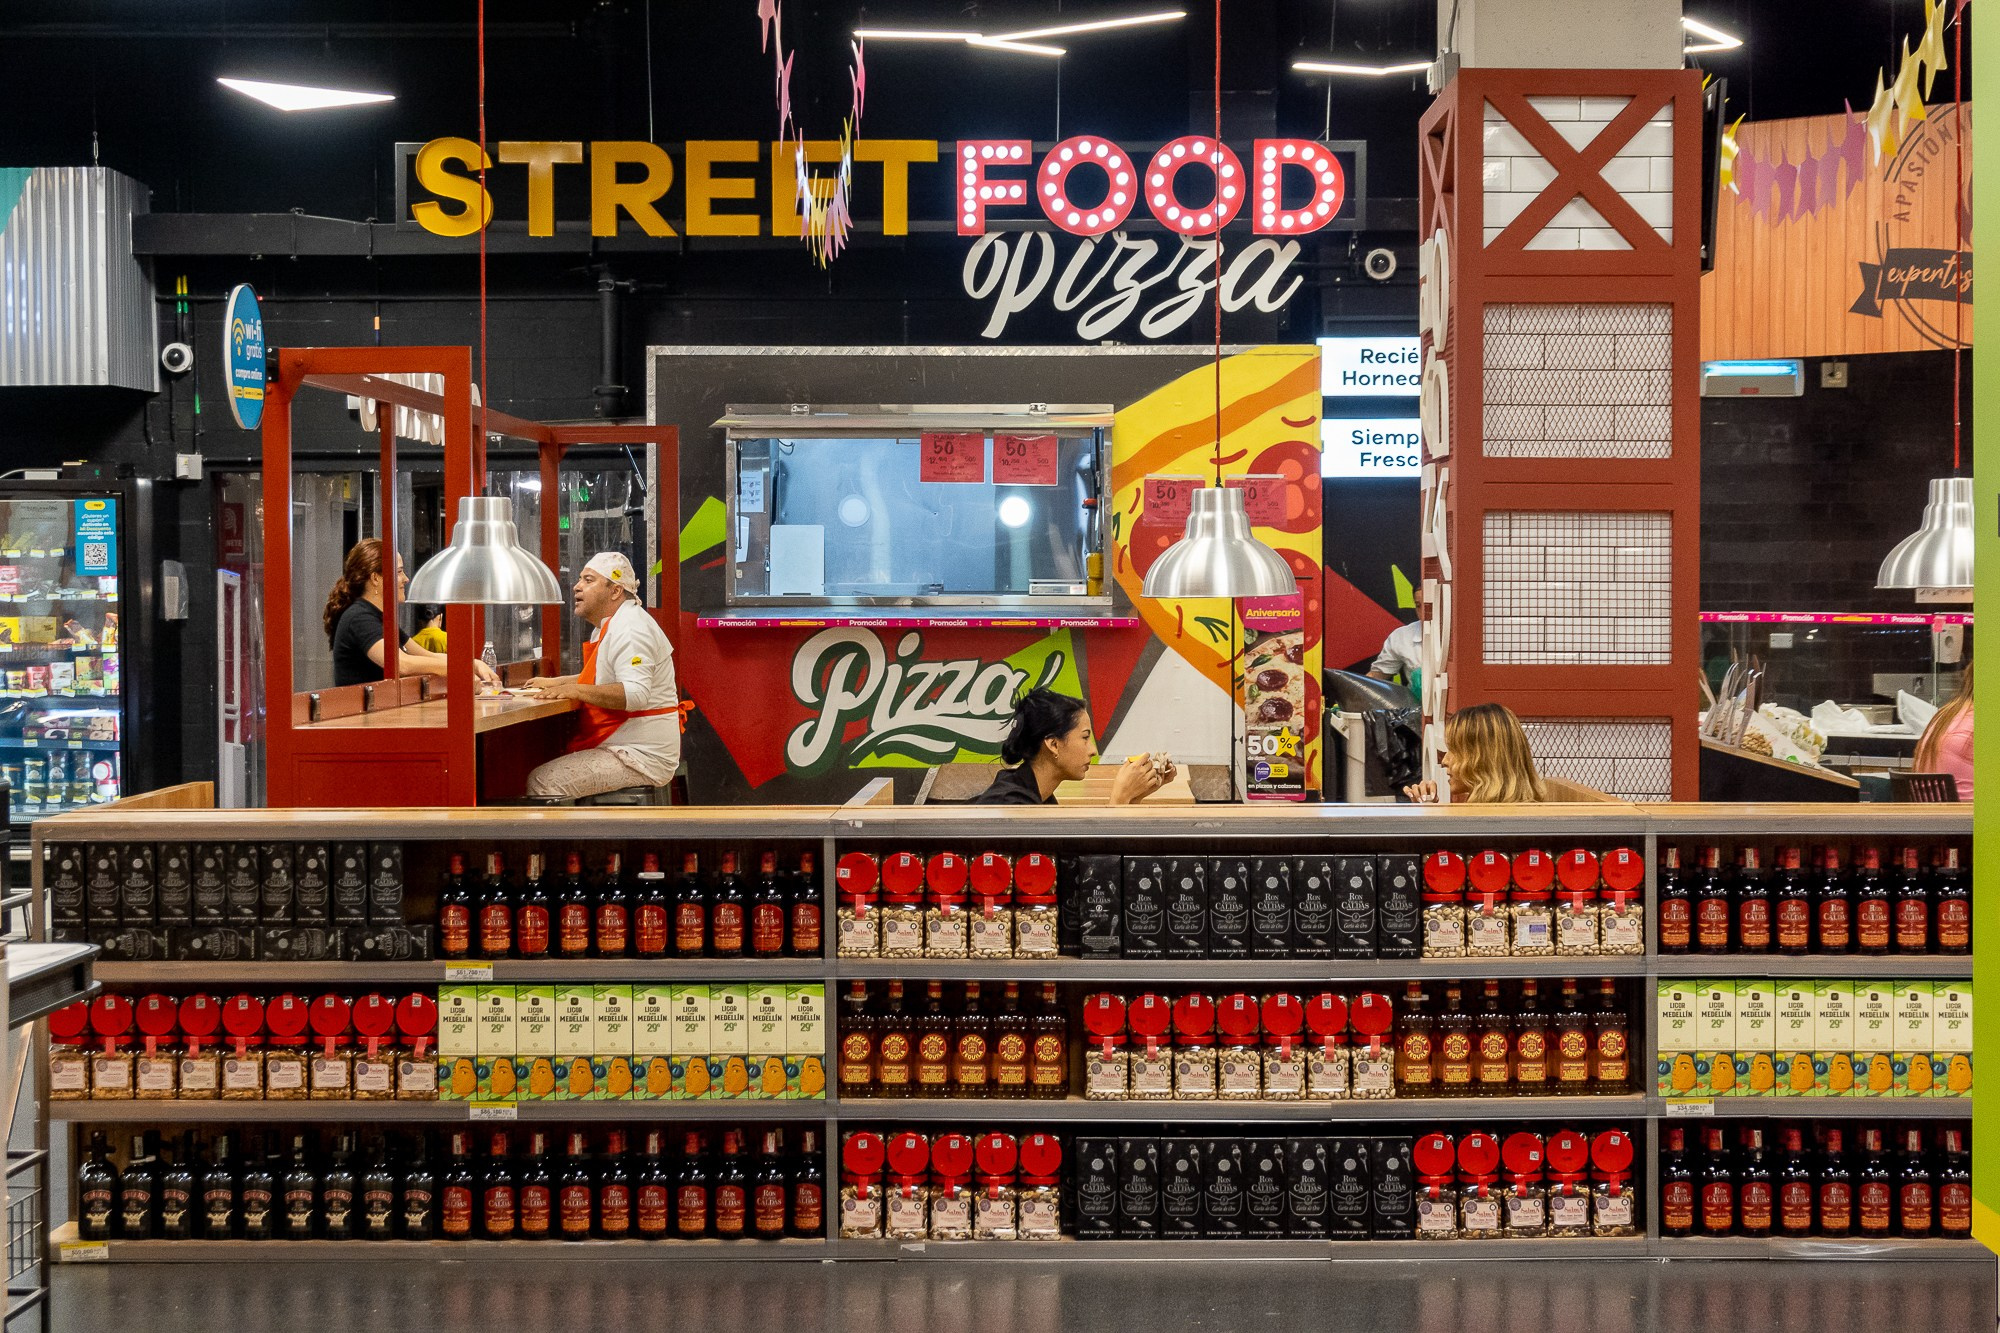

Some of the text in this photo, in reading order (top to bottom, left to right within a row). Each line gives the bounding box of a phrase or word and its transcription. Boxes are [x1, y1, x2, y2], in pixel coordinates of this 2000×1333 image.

[411, 135, 1345, 238] STREET FOOD
[1246, 608, 1301, 618] Aniversario
[787, 627, 1061, 767] Pizza
[1248, 735, 1278, 754] 50
[443, 1014, 473, 1022] MEDELLÍN
[482, 1014, 512, 1022] MEDELLÍN
[521, 1014, 550, 1022] MEDELLÍN
[598, 1014, 628, 1022] MEDELLÍN
[638, 1014, 667, 1022] MEDELLÍN
[715, 1013, 744, 1021] MEDELLÍN
[791, 1013, 821, 1021] MEDELLÍN
[1663, 1010, 1692, 1018] MEDELLÍN
[1702, 1010, 1731, 1018] MEDELLÍN
[1781, 1010, 1810, 1018] MEDELLÍN
[1859, 1010, 1889, 1018] MEDELLÍN
[1938, 1010, 1968, 1018] MEDELLÍN
